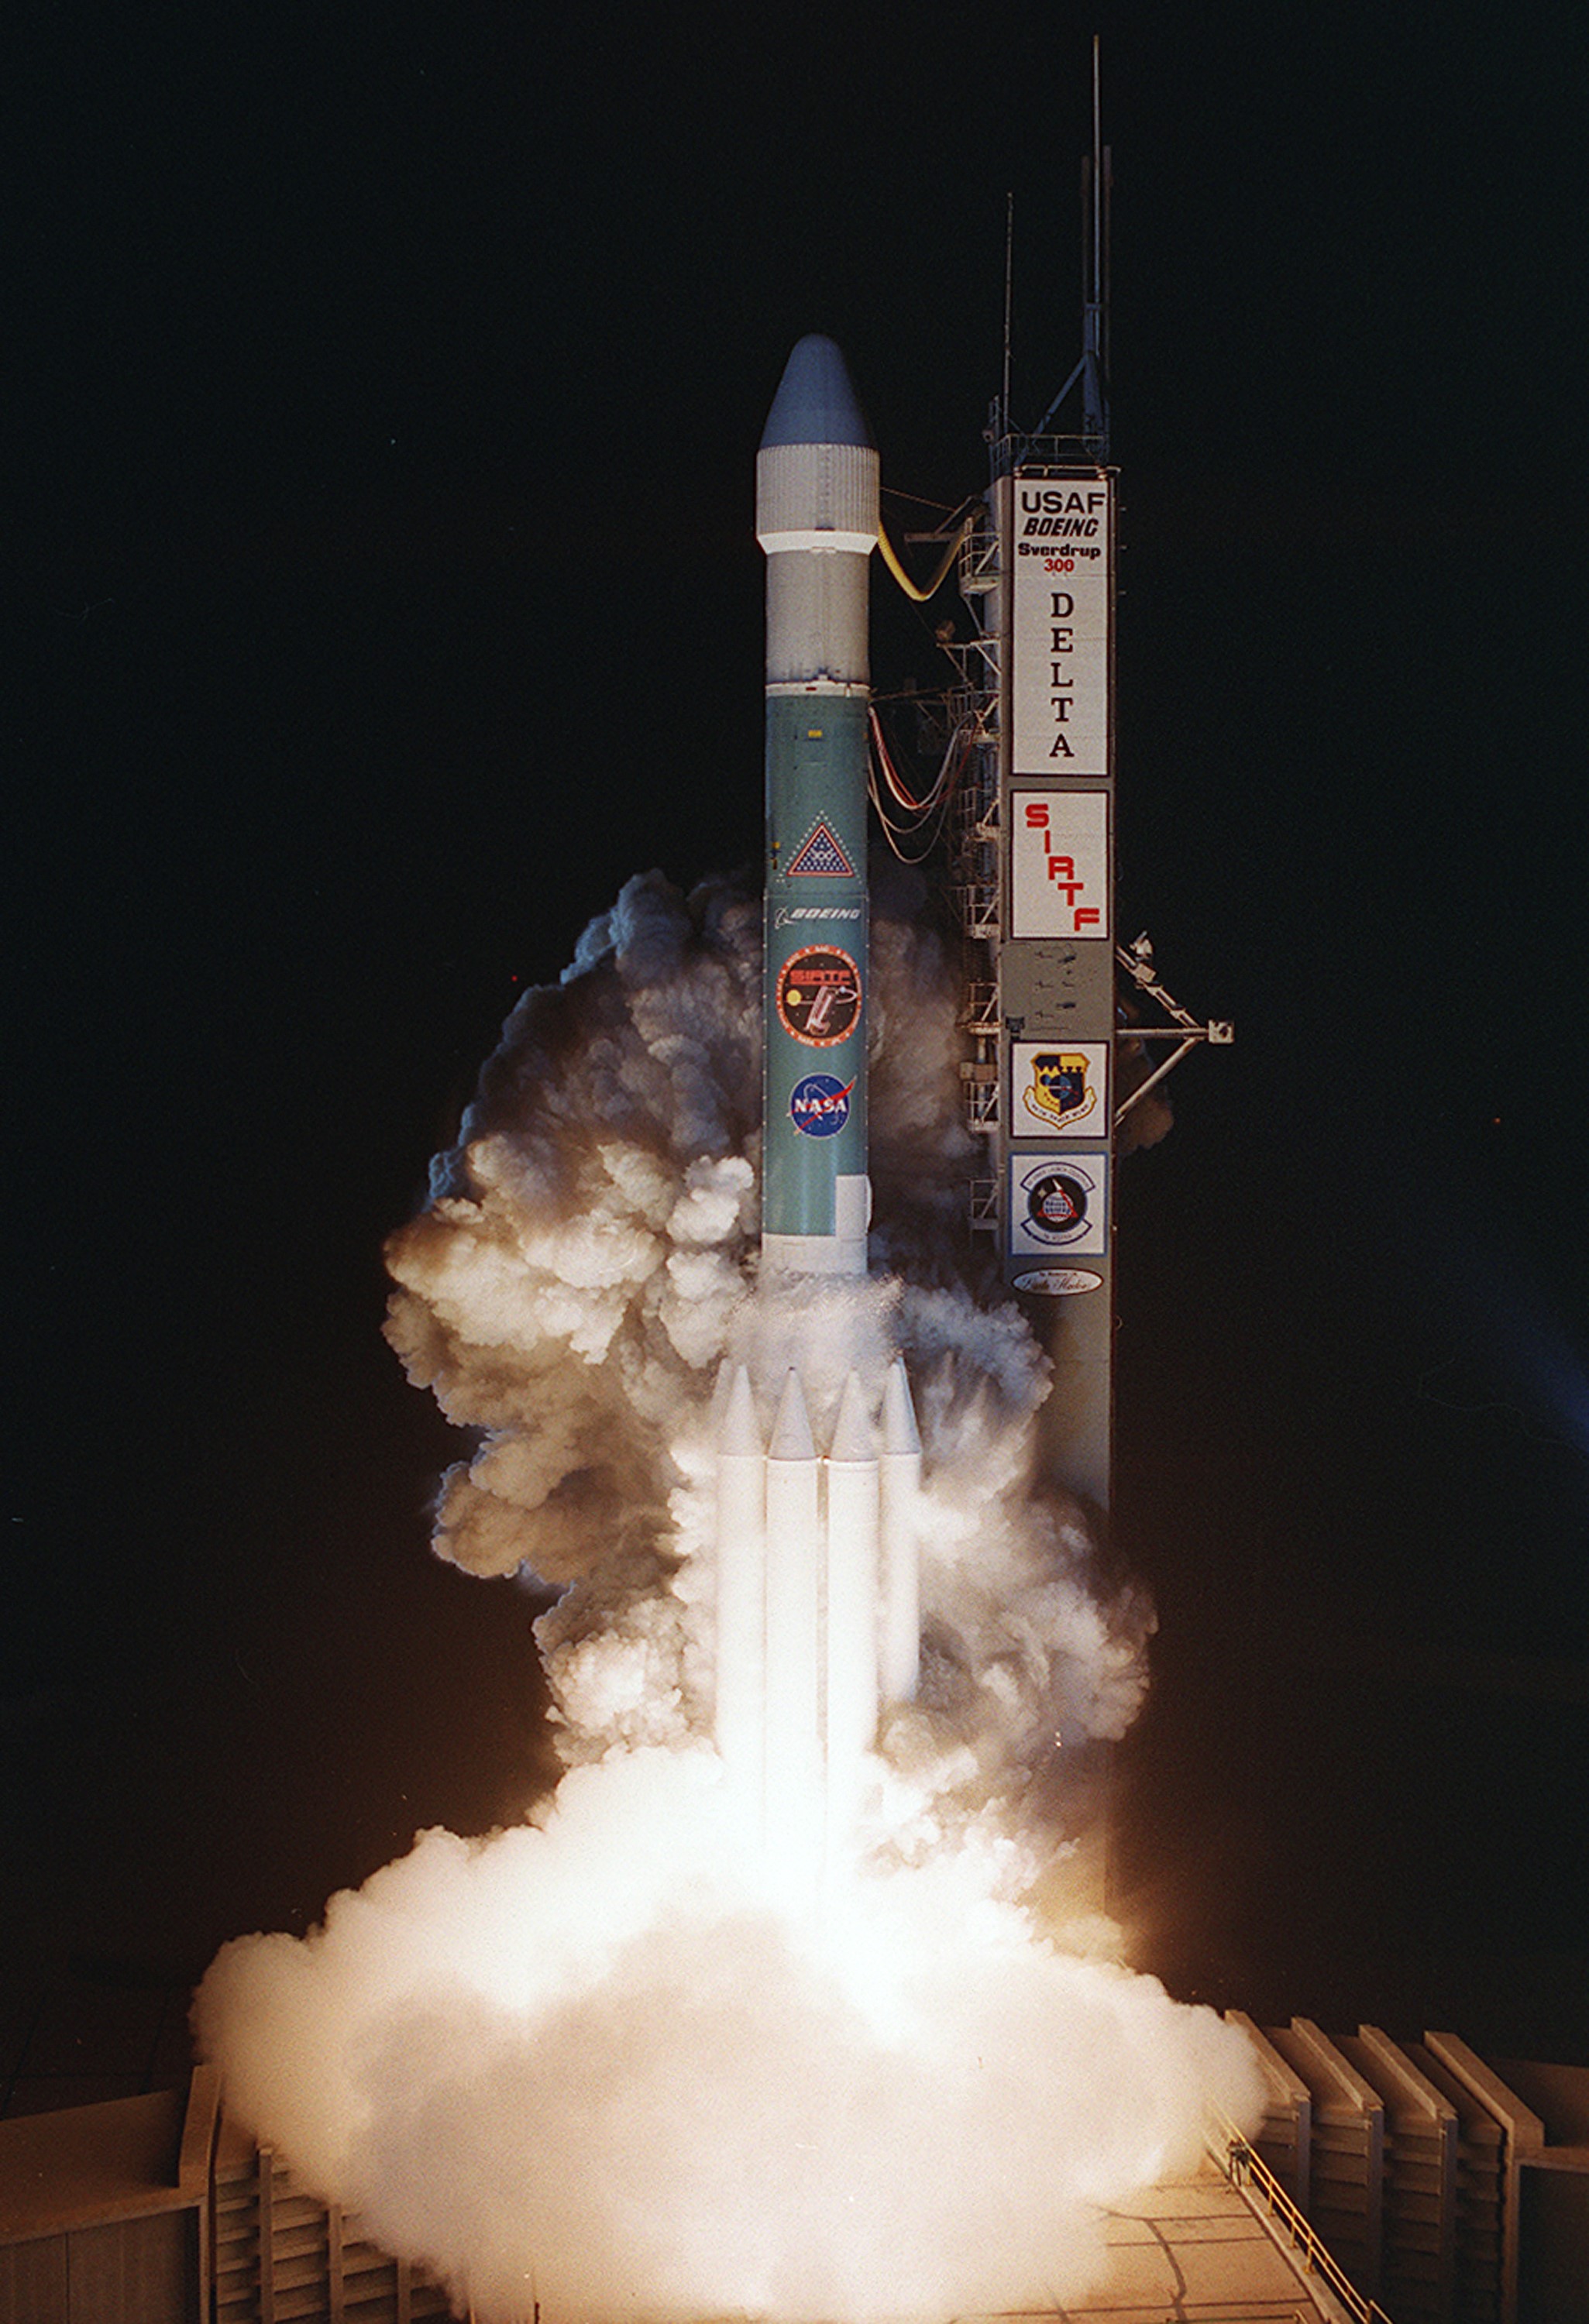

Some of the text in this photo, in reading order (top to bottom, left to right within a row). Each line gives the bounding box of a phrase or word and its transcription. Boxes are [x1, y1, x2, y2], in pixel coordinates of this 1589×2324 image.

[1022, 491, 1106, 514] USAF
[1023, 517, 1099, 537] BOEING
[1018, 543, 1101, 560] Sverdrup
[1044, 559, 1075, 572] 300
[1049, 593, 1075, 758] DELTA
[1025, 803, 1100, 932] SIRTF
[790, 907, 861, 920] BOEING
[795, 1098, 848, 1114] NASA
